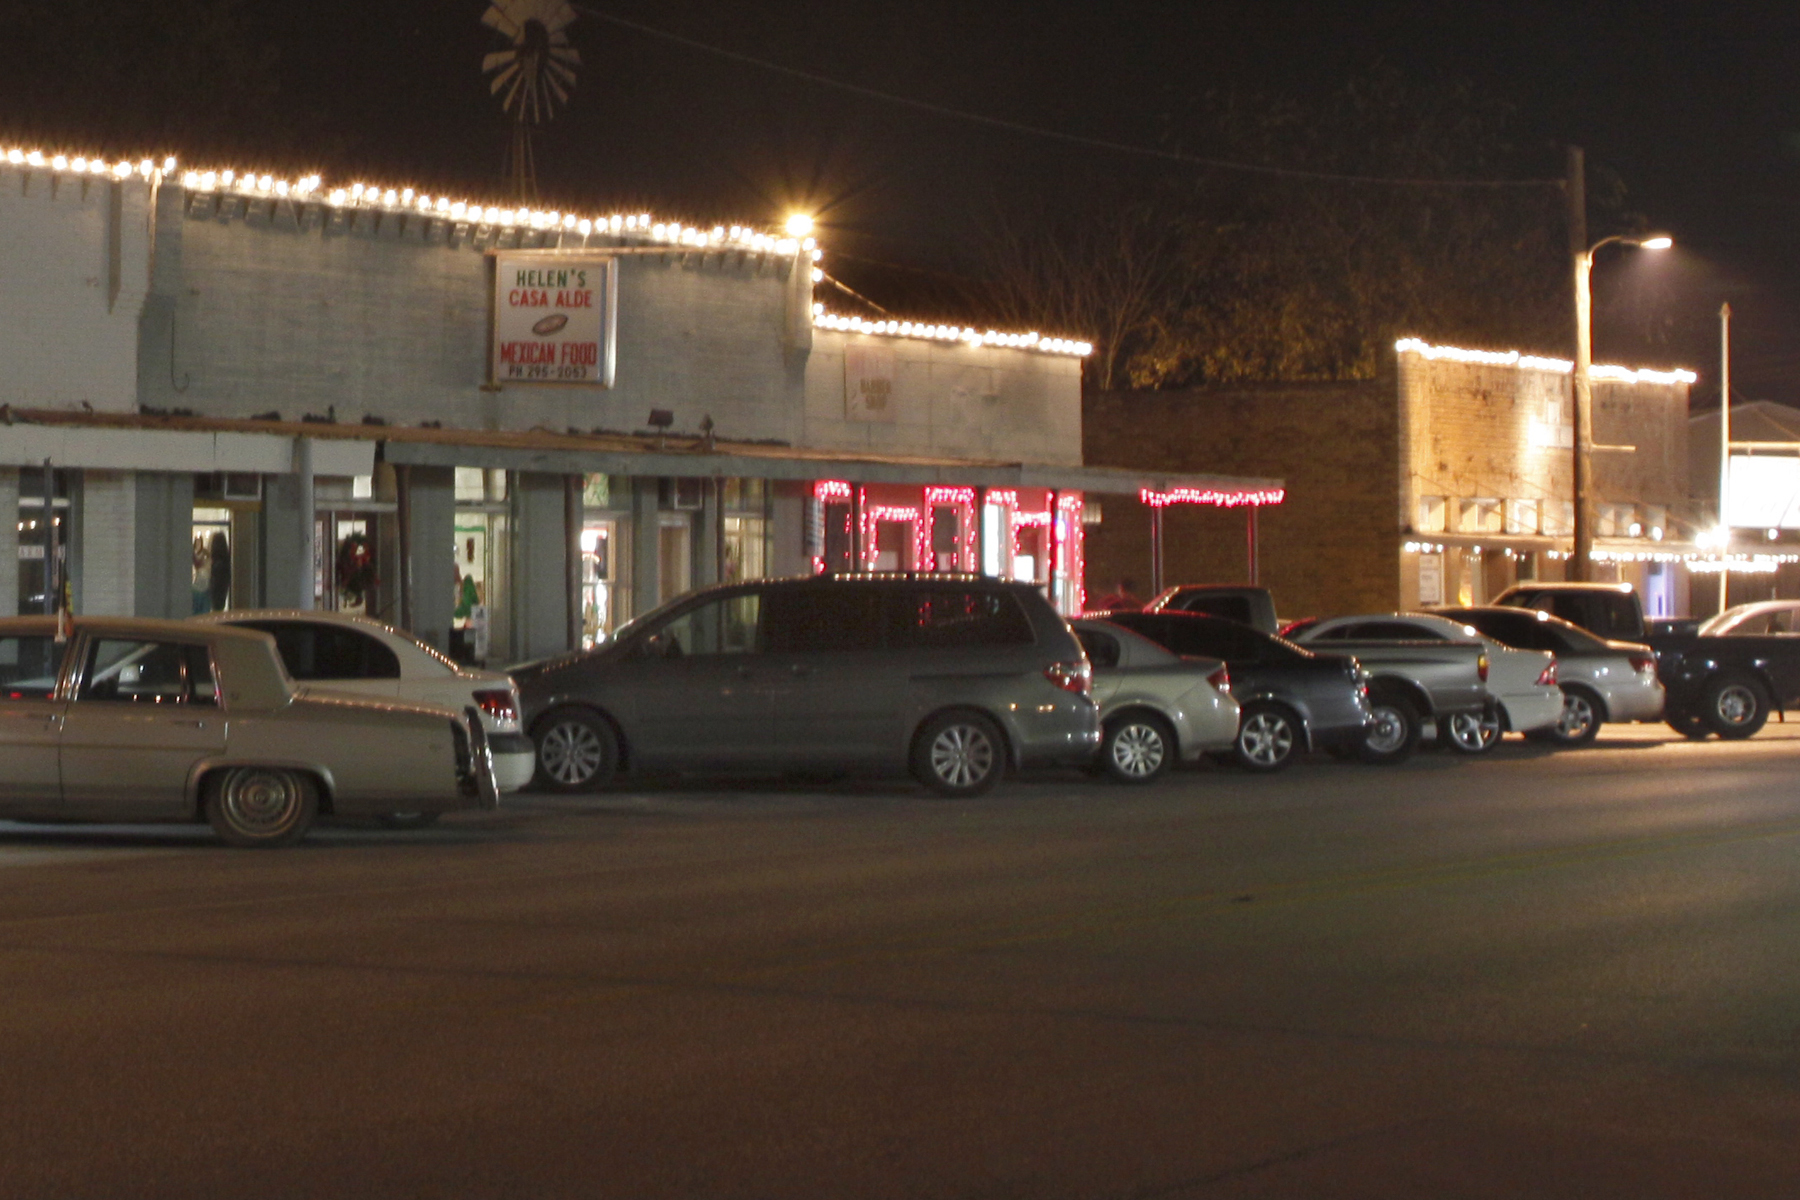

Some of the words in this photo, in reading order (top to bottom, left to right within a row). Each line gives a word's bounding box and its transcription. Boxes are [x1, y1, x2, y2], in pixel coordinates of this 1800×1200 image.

[516, 269, 587, 288] HELEN'S
[508, 289, 549, 307] CASA
[555, 289, 593, 308] ALDE
[500, 341, 556, 365] MEXICAN
[561, 341, 598, 366] FOOD
